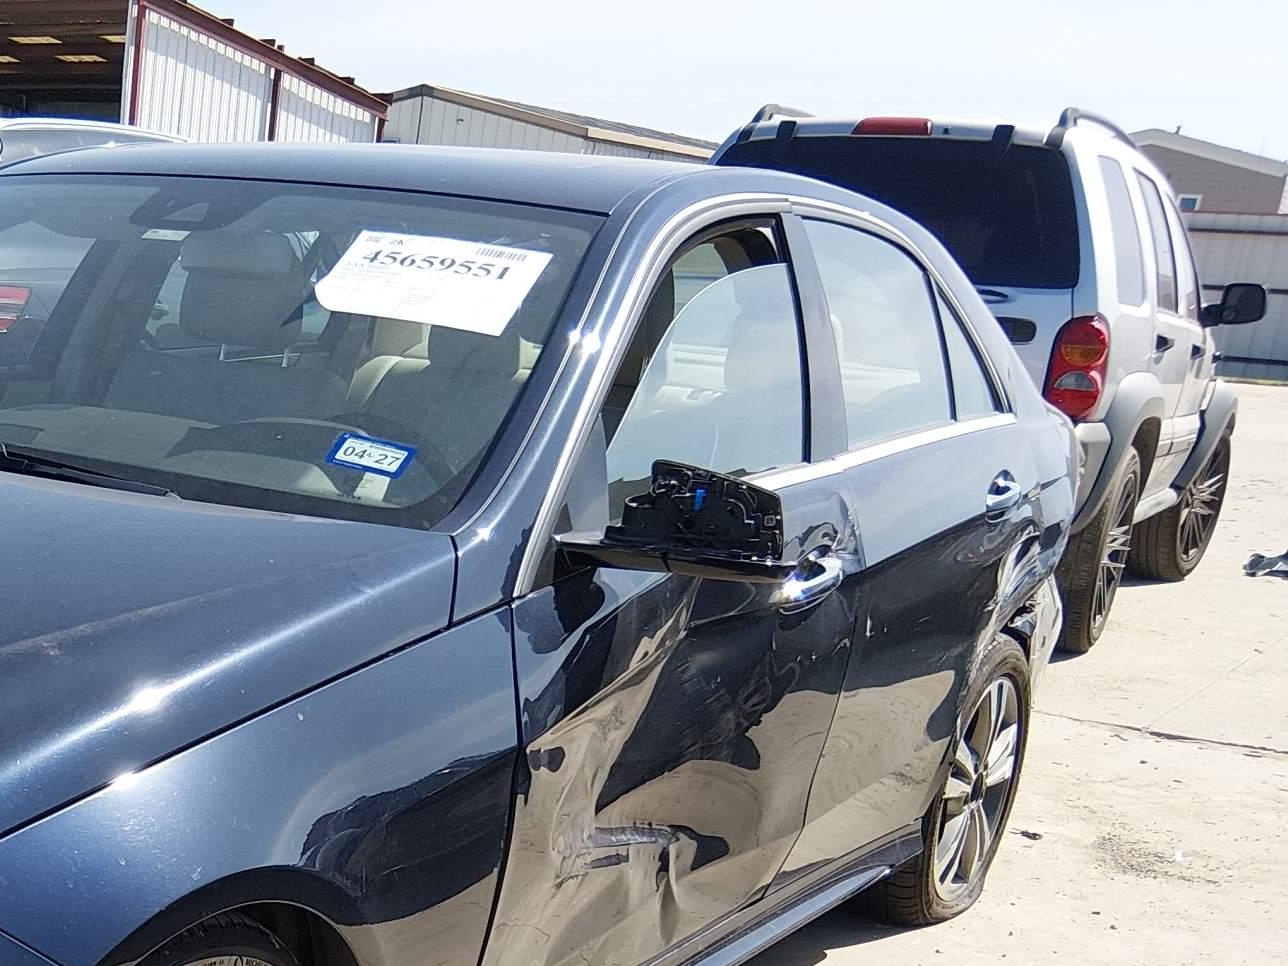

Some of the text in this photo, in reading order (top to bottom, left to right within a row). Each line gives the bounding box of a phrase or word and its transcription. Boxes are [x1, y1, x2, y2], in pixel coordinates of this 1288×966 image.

[363, 249, 512, 281] 45659551
[343, 445, 368, 460] 04
[373, 453, 401, 467] 27
